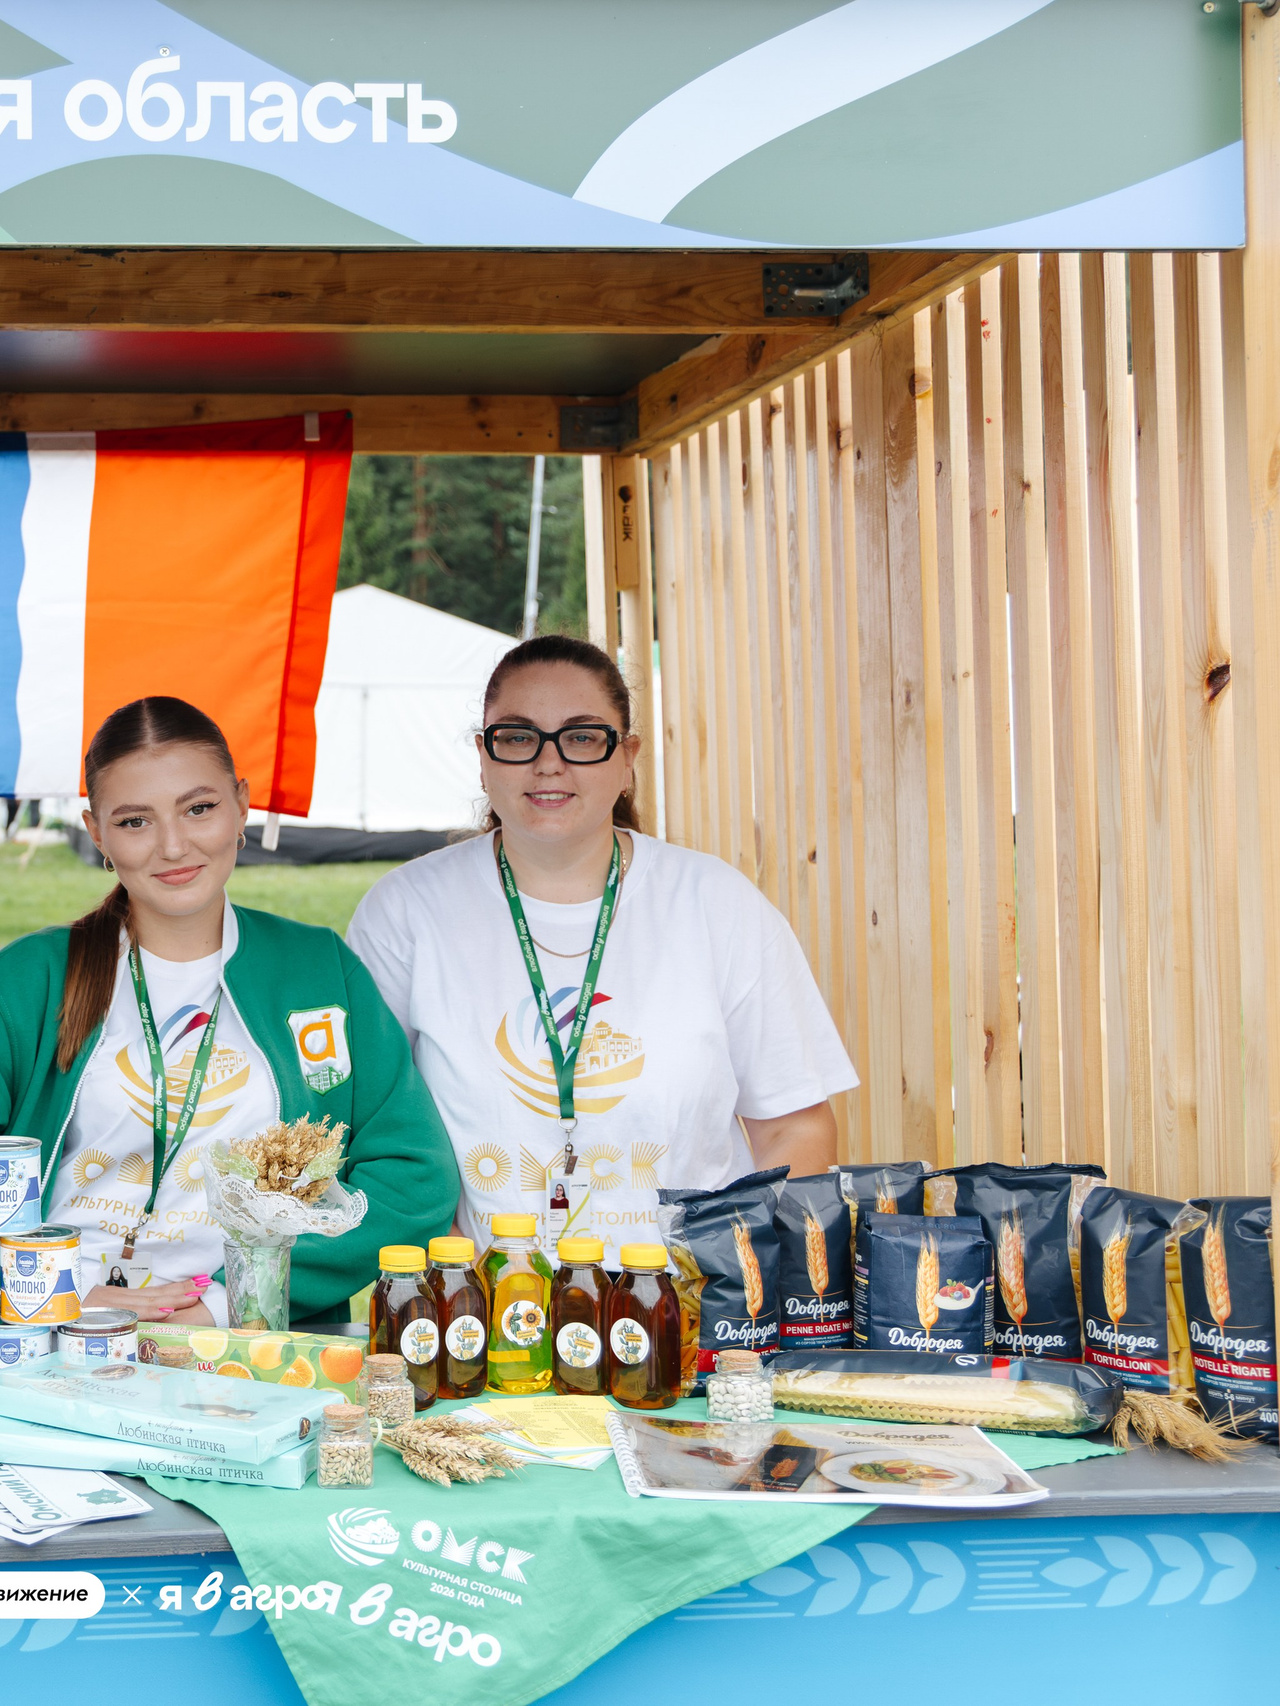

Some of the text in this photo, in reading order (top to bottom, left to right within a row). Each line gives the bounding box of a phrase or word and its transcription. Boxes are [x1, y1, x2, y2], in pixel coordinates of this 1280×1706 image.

[63, 53, 458, 144] область
[597, 905, 610, 939] влюблён
[524, 941, 538, 973] влюблён
[580, 982, 593, 1014] работаю
[144, 1025, 157, 1055] влюблён
[188, 1069, 202, 1104] работаю
[179, 1113, 190, 1131] агро
[9, 1279, 46, 1294] МОЛОКО
[785, 1297, 851, 1320] Добродея
[714, 1320, 778, 1351] Добродея
[786, 1325, 814, 1335] PENNE
[815, 1323, 842, 1333] RIGATE
[888, 1327, 964, 1352] Добродея
[1085, 1319, 1158, 1354] Добродея
[1190, 1320, 1271, 1359] Добродея
[1091, 1352, 1151, 1372] TORTIGLIONI
[1194, 1356, 1271, 1378] ROTELLE RIGATE
[1259, 1411, 1279, 1424] 400
[117, 1421, 226, 1454] Любинская птичка
[837, 1430, 954, 1443] Добродея
[136, 1457, 264, 1481] Любинская птичка
[411, 1519, 535, 1585] ОМСК
[402, 1558, 523, 1606] КУЛЬТУРНАЯ СТОЛИЦА
[429, 1582, 486, 1608] 2026 ГОДА
[348, 1582, 394, 1626] в
[388, 1607, 502, 1668] агро
